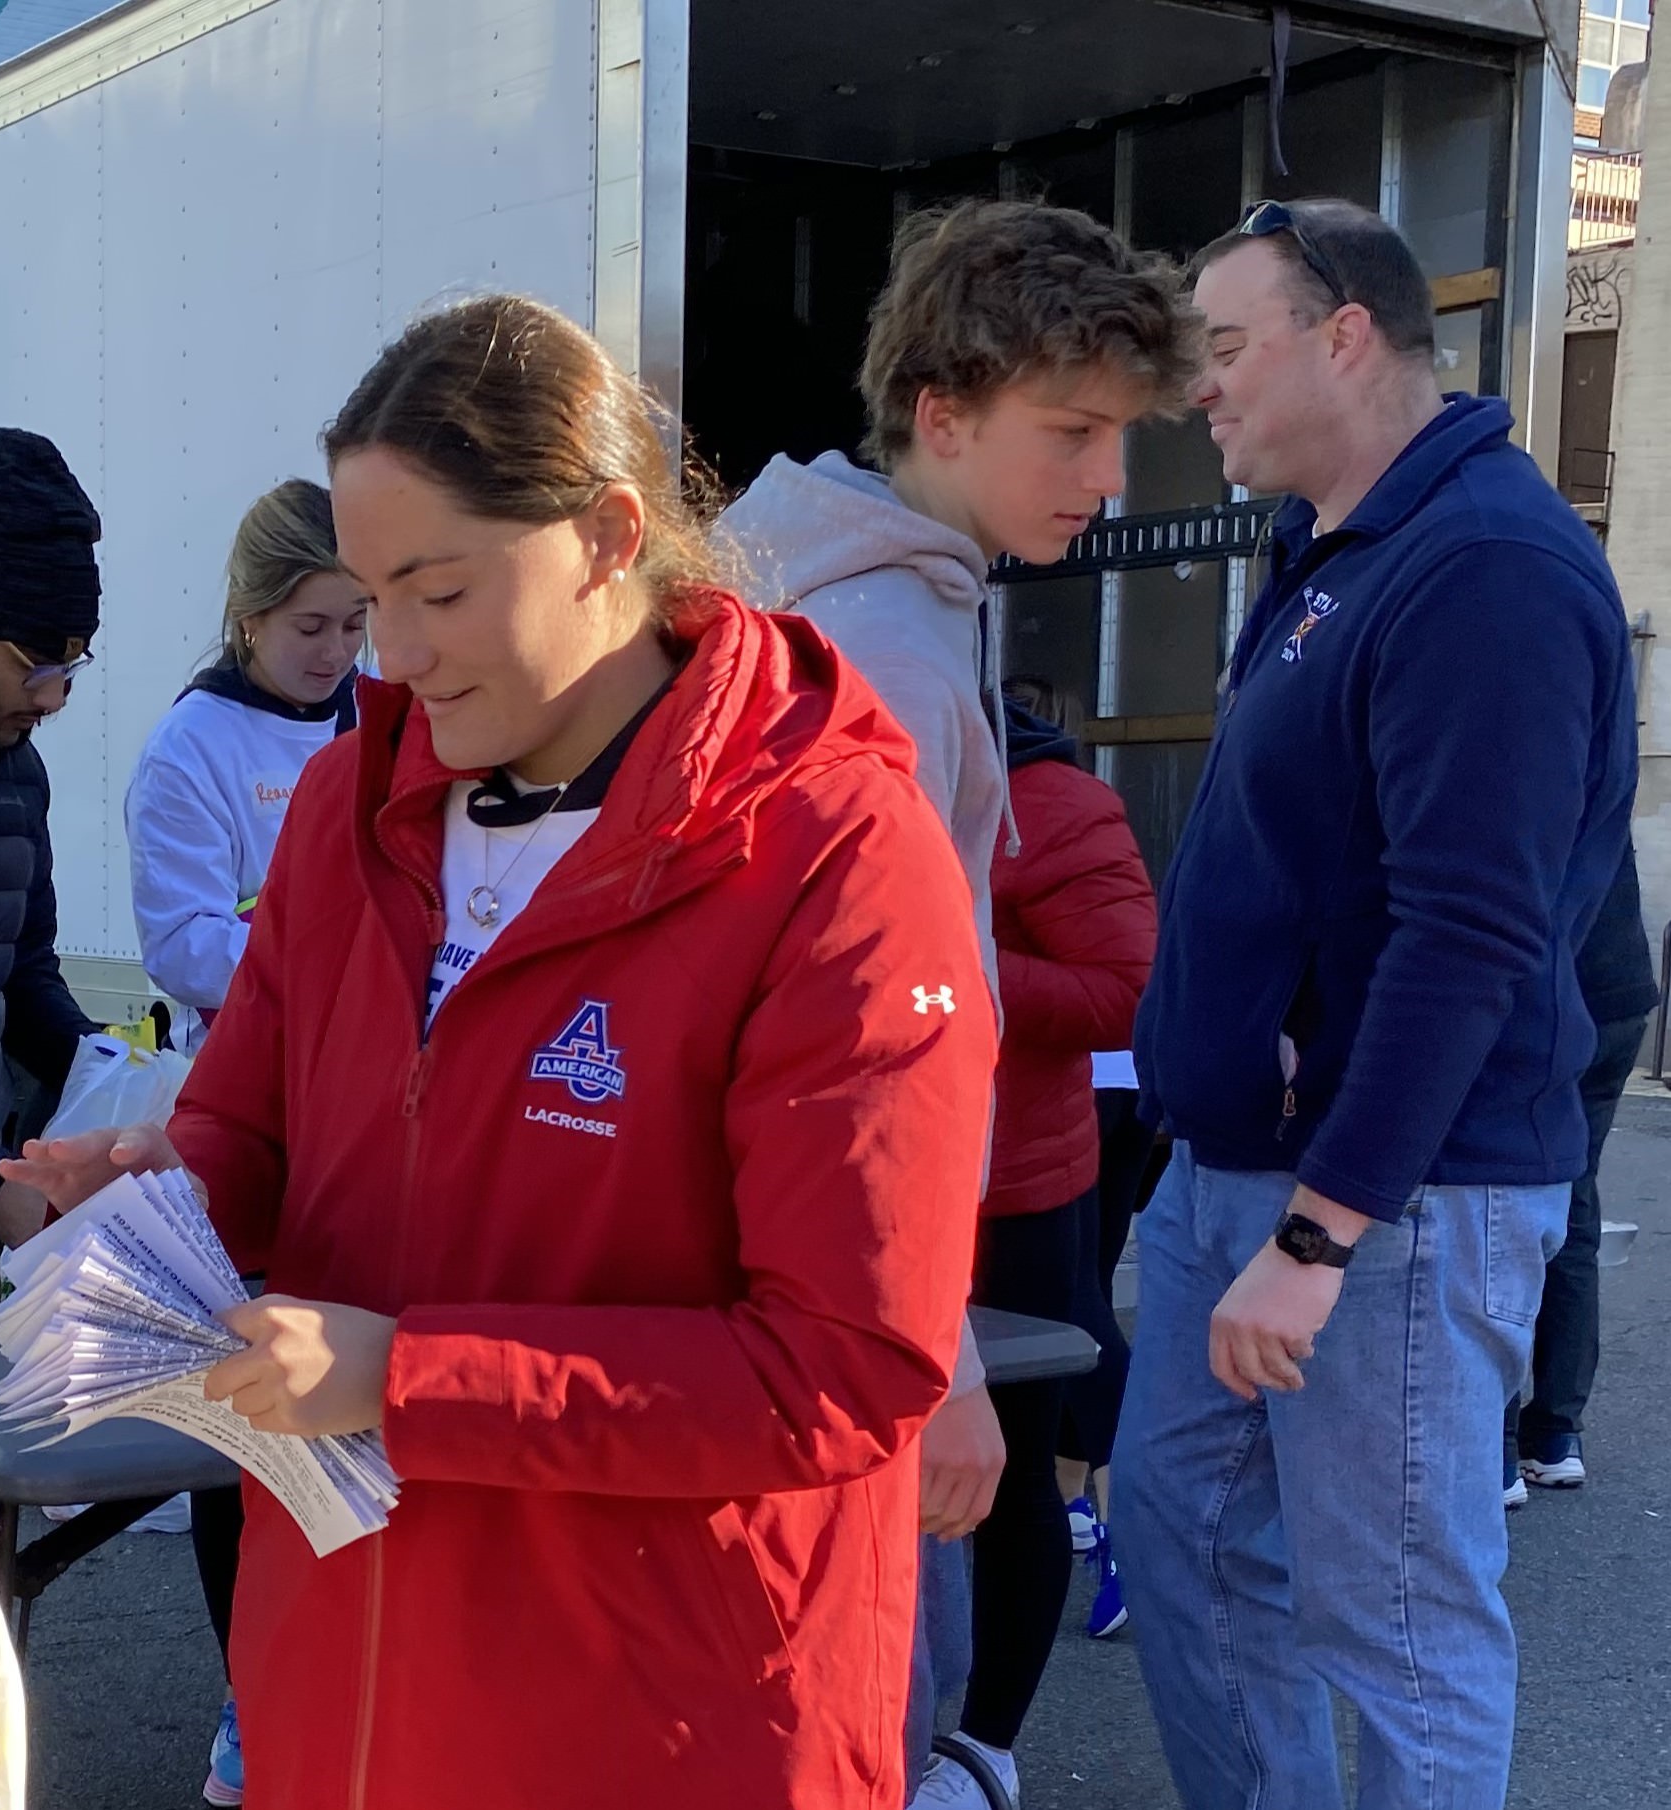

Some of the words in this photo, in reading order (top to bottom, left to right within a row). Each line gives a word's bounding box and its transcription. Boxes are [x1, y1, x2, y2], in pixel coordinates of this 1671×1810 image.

[538, 1060, 624, 1089] AMERICAN
[524, 1106, 618, 1138] LACROSSE
[100, 1222, 138, 1260] January
[112, 1212, 136, 1238] 2023
[136, 1238, 162, 1265] dates
[162, 1265, 213, 1317] COLUMBIA
